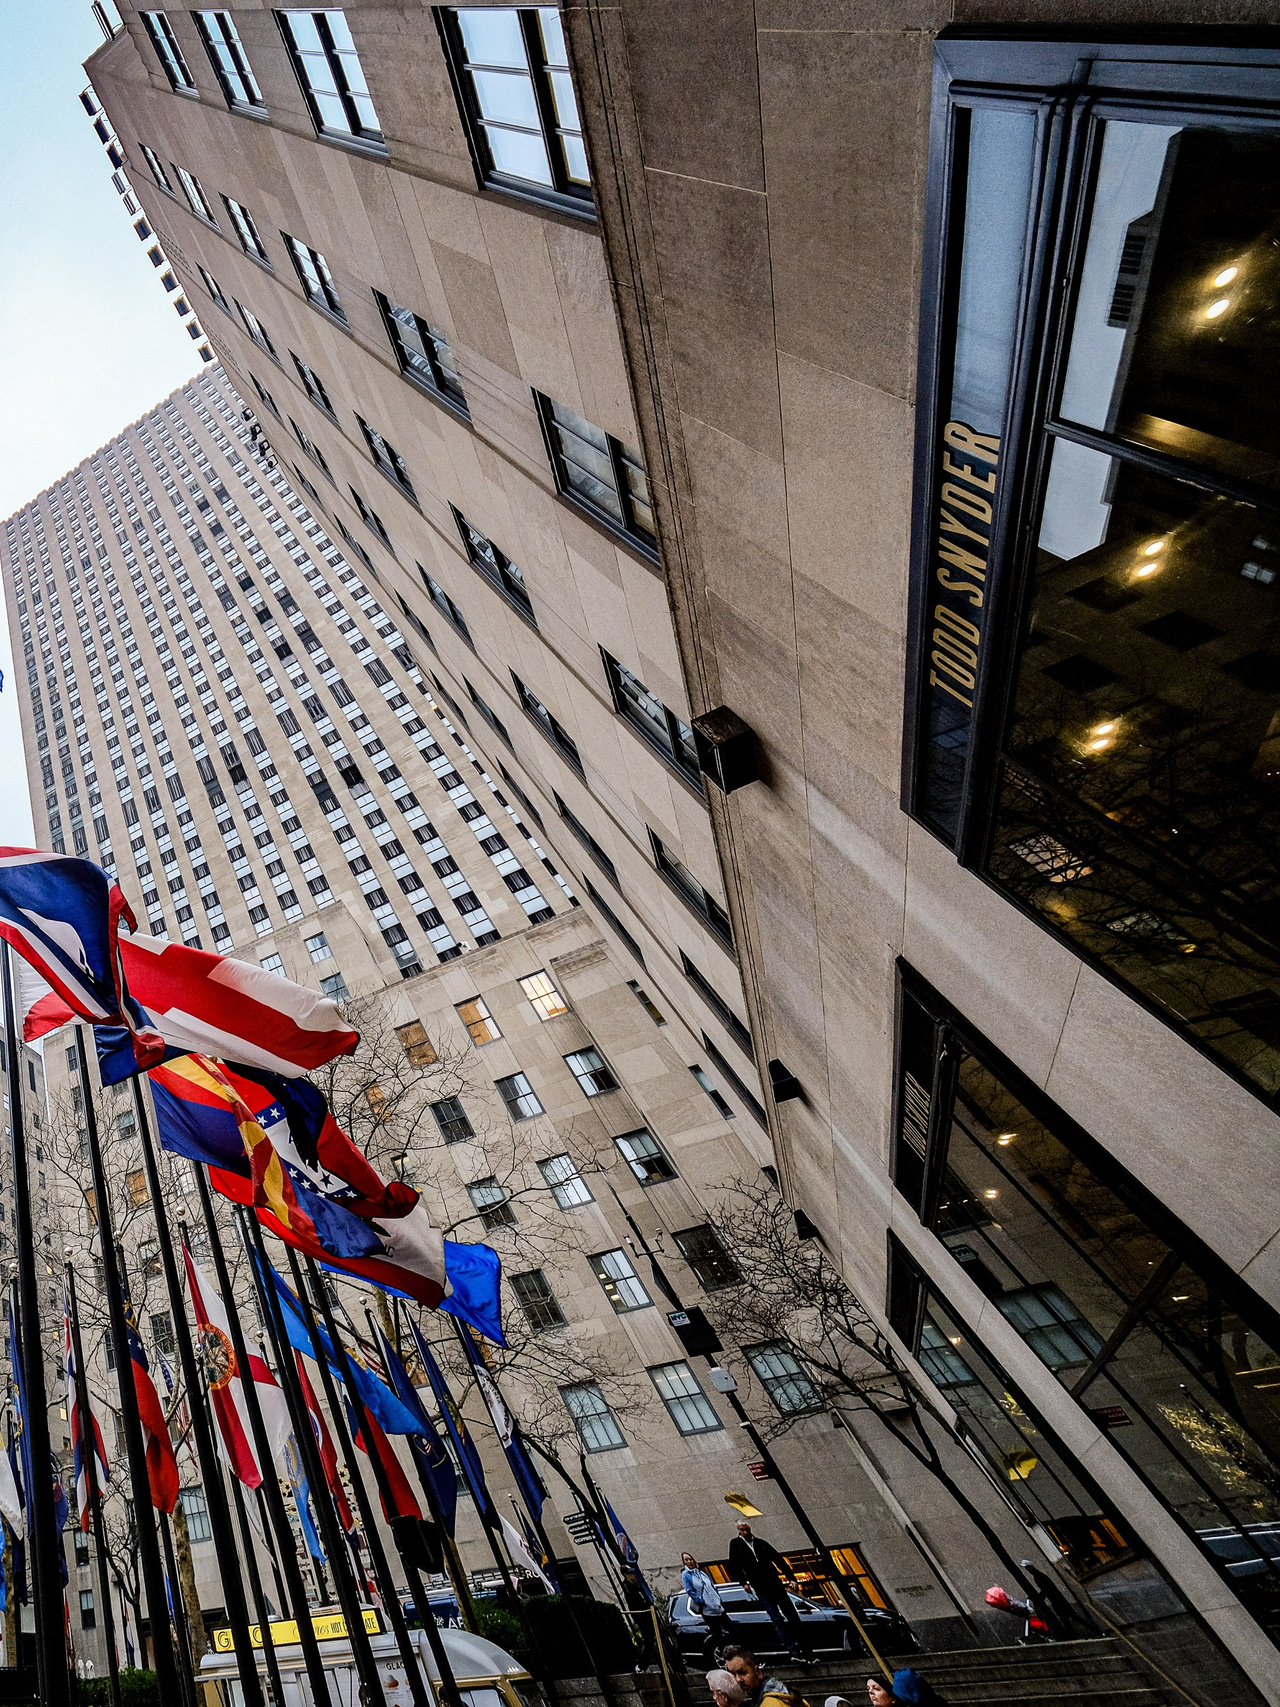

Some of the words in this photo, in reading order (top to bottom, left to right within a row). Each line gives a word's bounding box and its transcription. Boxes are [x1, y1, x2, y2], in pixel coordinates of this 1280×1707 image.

[936, 421, 1001, 608] SNYDER
[929, 604, 980, 708] TODD
[904, 1070, 931, 1134] SNYDER
[902, 1116, 927, 1163] TODD
[330, 1621, 343, 1634] HOT
[386, 1661, 405, 1671] GLAC
